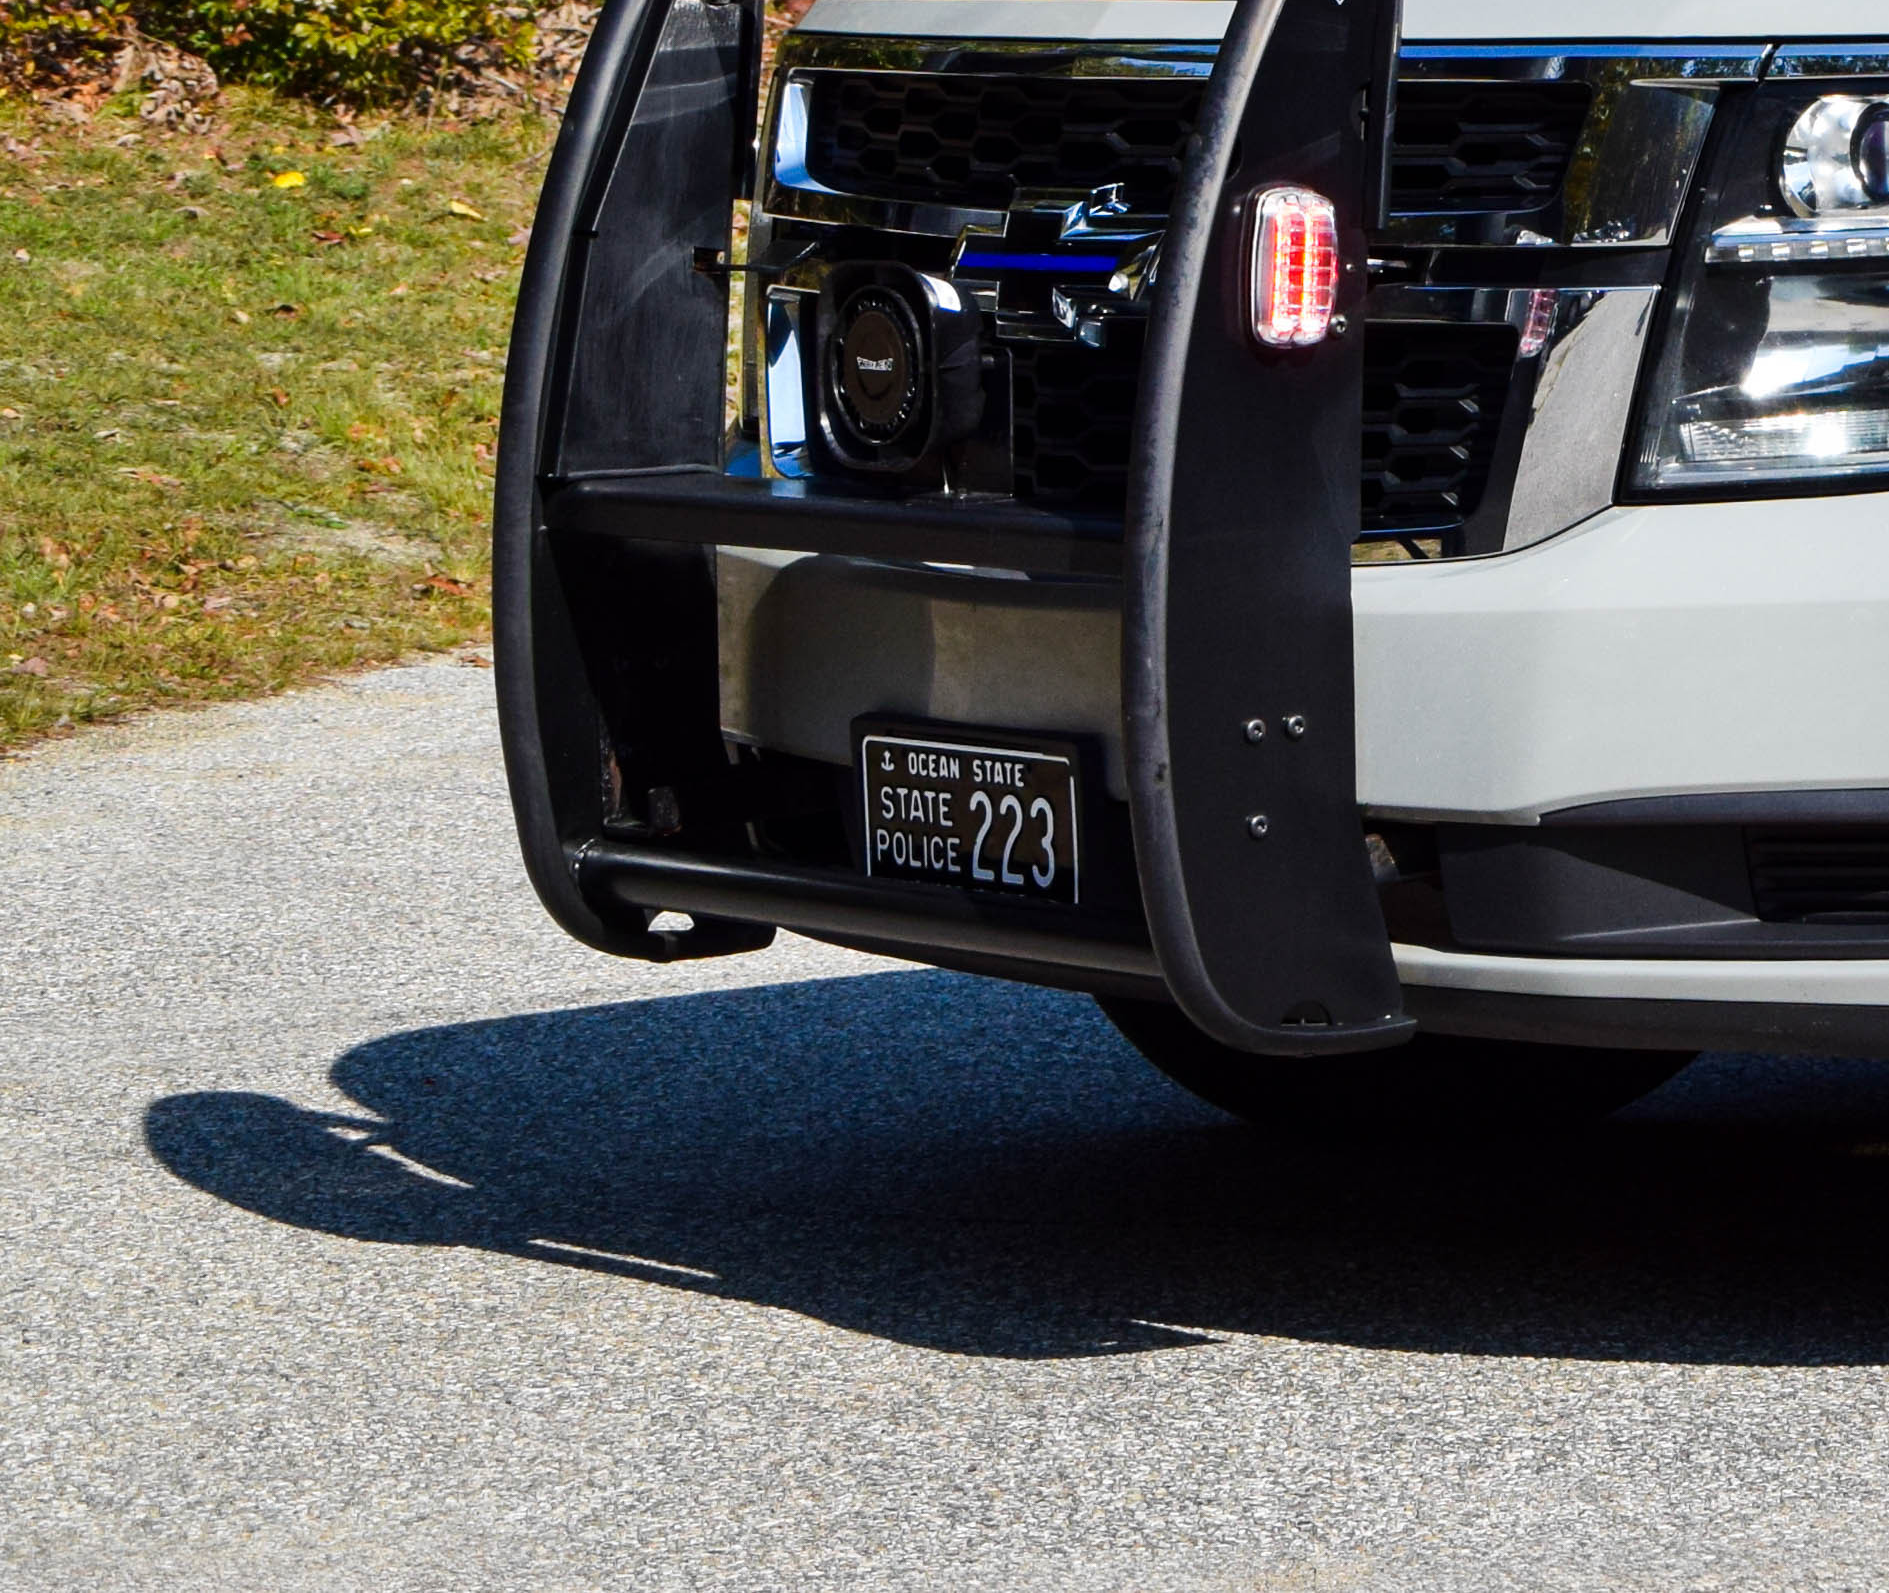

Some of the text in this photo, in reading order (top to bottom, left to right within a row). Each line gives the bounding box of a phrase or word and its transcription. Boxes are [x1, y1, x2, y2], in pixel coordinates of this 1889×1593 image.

[907, 751, 1026, 788] OCEAN STATE
[880, 786, 953, 827] STATE
[876, 828, 961, 873] POLICE
[969, 790, 1055, 888] 223
